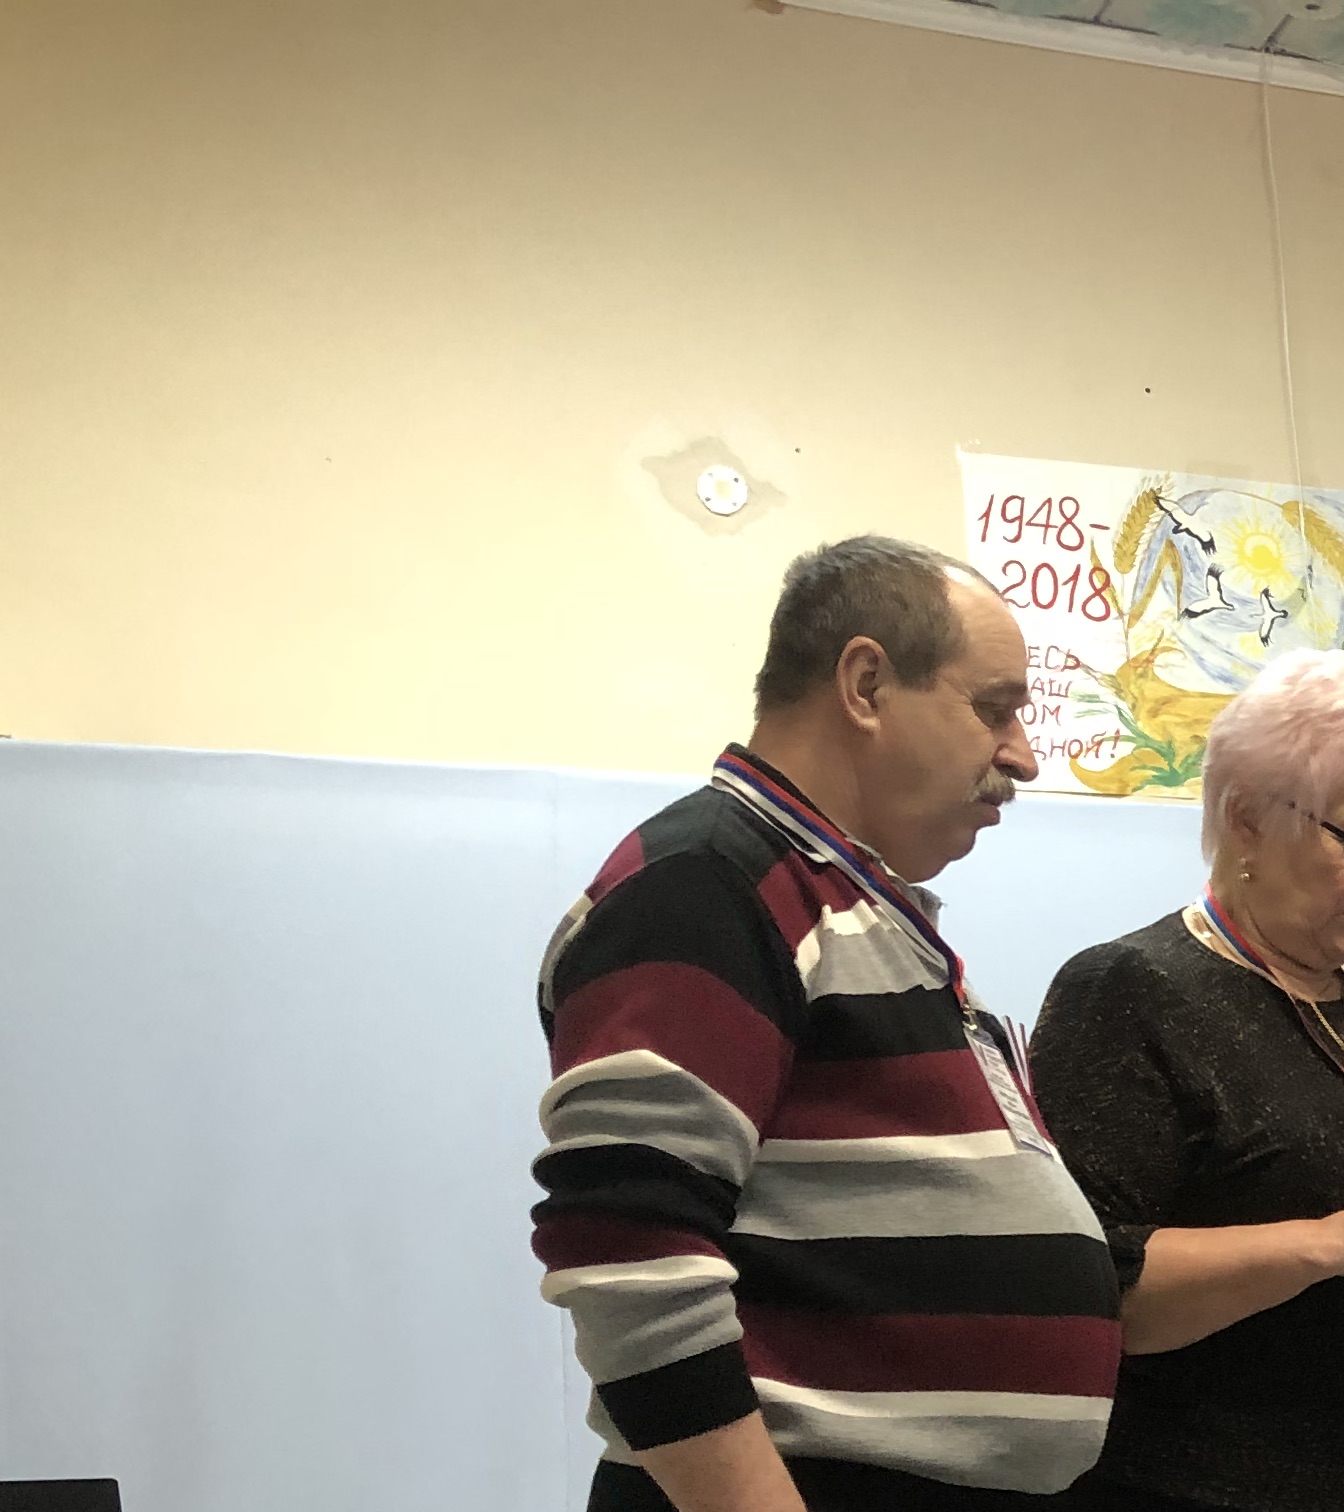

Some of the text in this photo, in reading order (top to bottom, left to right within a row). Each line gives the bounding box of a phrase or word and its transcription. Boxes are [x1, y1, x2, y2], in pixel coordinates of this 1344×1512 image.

[977, 493, 1111, 552] 1948-
[1001, 559, 1111, 622] 2018
[1026, 644, 1081, 672] ЕСЬ
[1030, 676, 1074, 698] АШ
[1019, 702, 1062, 727] ОМ
[1029, 728, 1121, 761] ДНОЙ!
